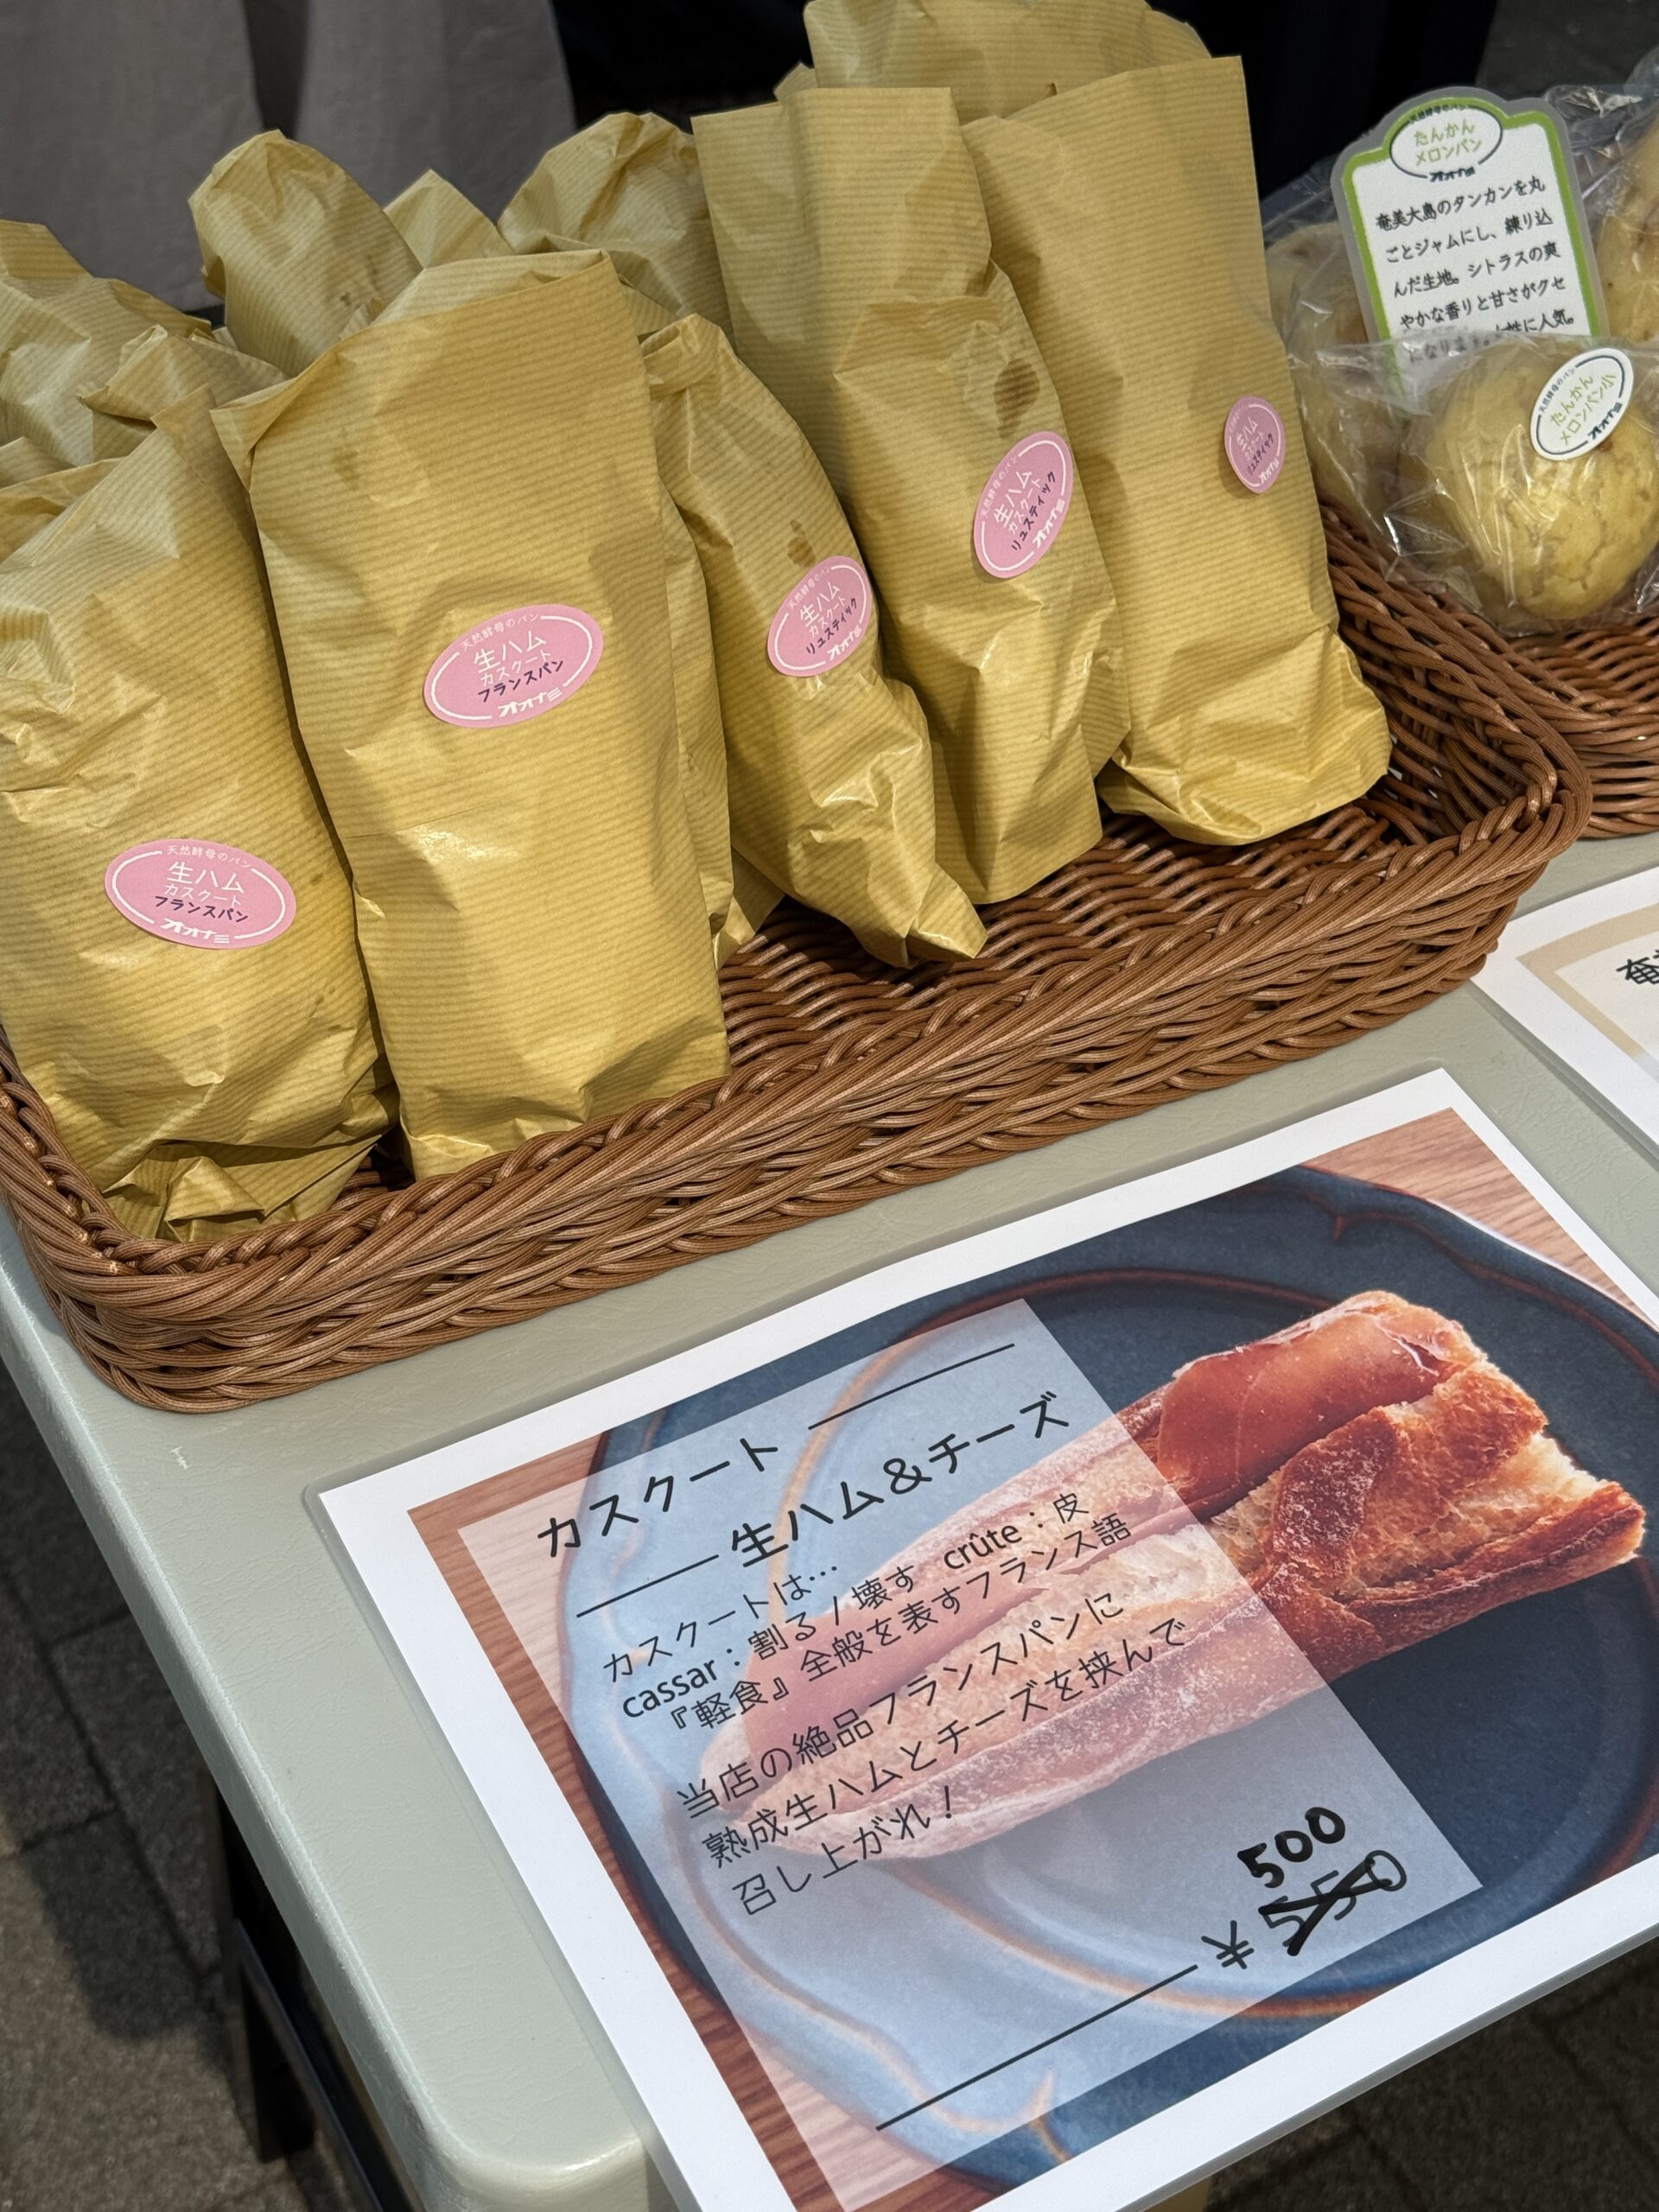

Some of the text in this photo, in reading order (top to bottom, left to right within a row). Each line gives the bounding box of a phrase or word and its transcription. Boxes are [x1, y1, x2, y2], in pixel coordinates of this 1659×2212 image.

[1414, 118, 1474, 147] たんかん
[1416, 139, 1482, 166] メロンパン
[1376, 175, 1545, 231] 奄美大島のタンカンを丸
[1386, 208, 1554, 263] ごとジャムにし、練り込
[1394, 241, 1560, 297] んだ生地。シトラスの爽
[1400, 276, 1566, 329] やかな香りと甘さがクセ
[1551, 376, 1593, 426] たんかん
[1560, 375, 1617, 446] メロンパン小
[994, 471, 1033, 528] 生ハム
[1008, 478, 1040, 535] カスクート
[1011, 471, 1056, 551] リュスティック
[800, 582, 840, 627] 生ハム
[806, 597, 857, 655] リュスティック
[809, 596, 846, 638] カスクート
[460, 613, 539, 652] 天然酵母のパン
[474, 631, 547, 673] 生ハム
[478, 660, 563, 702] フランスパン
[480, 649, 550, 687] カスクート
[167, 845, 252, 869] 天然酵母のパン
[167, 861, 245, 893] 生ハム
[155, 895, 249, 923] フランスパン
[164, 883, 241, 907] カスクート
[537, 1437, 779, 1557] カスクート
[731, 1390, 1070, 1567] 生ハム&チーズ
[670, 1512, 1131, 1731] 『軽食』全般を表すフランス語
[677, 1592, 1123, 1819] 当店の絶品フランスパンに
[702, 1617, 1187, 1869] 熟成生ハムとチーズを挟んで
[732, 1784, 955, 1915] 召し上がれ！
[1236, 1806, 1345, 1888] 500
